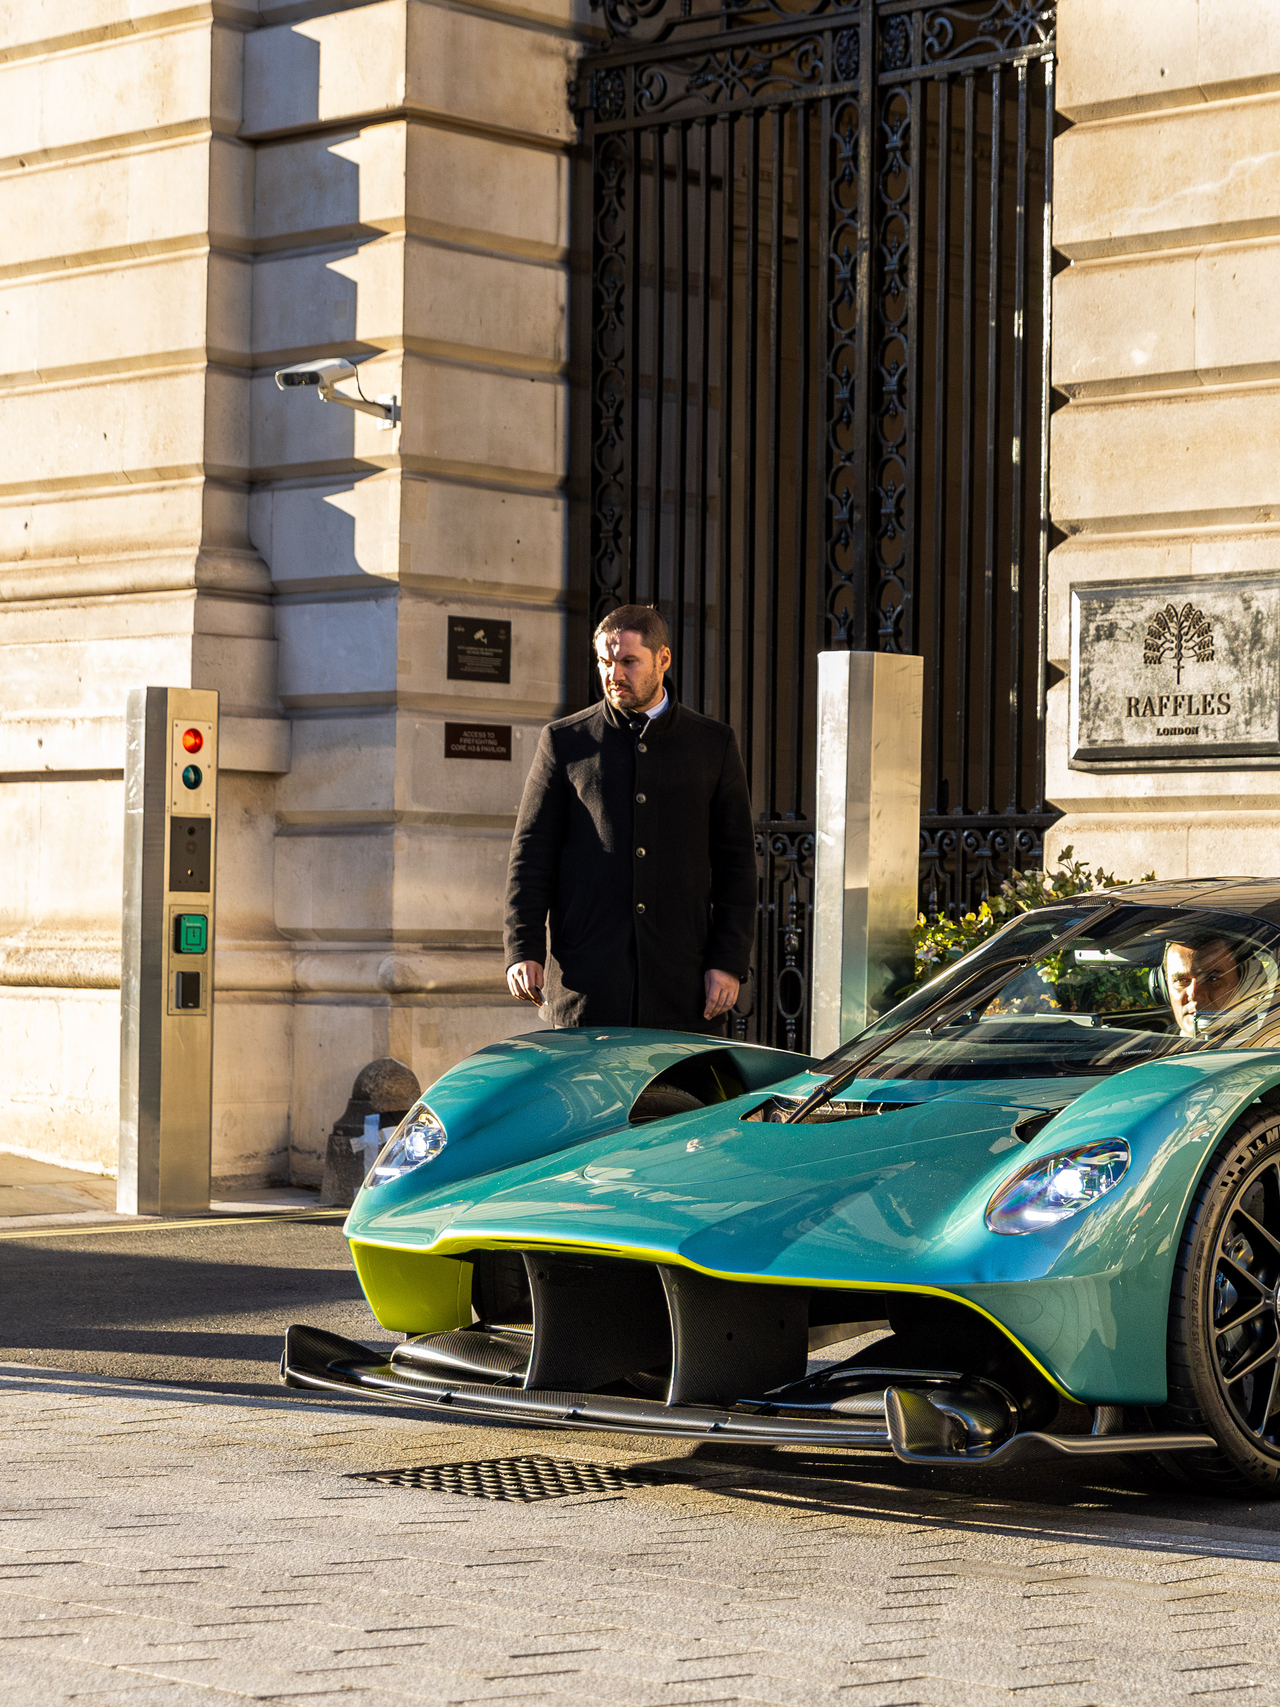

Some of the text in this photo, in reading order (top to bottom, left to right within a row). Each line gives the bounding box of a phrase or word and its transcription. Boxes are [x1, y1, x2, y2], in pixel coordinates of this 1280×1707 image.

[1125, 692, 1231, 718] RAFFLES
[462, 730, 496, 739] ACCESS TO
[1155, 726, 1200, 737] LONDON
